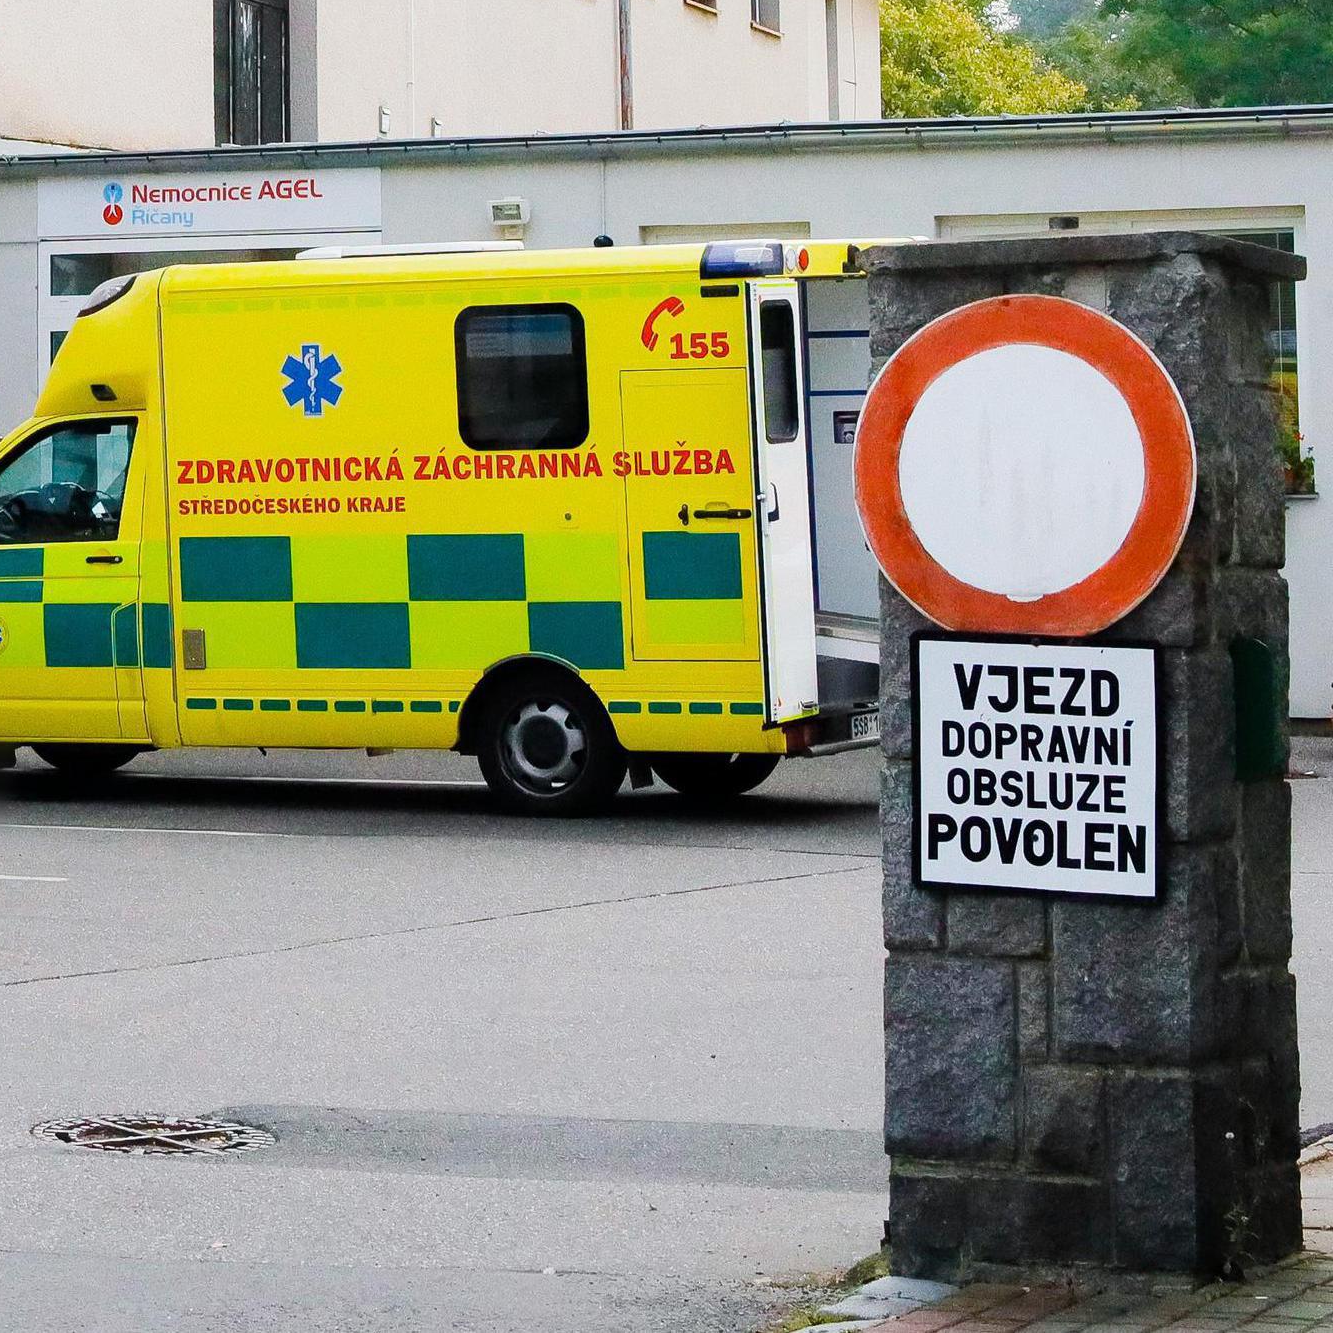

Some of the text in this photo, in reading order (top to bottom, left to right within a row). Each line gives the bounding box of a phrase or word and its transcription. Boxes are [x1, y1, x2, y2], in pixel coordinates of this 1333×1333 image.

[131, 179, 323, 204] Nemocnice AGEL
[131, 205, 194, 227] Říčany
[669, 332, 730, 360] 155
[177, 440, 736, 485] ZDRAVOTNICKÁ ZÁCHRANNÁ SLUŽBA
[178, 493, 406, 515] STŘEDOČESKÉHO KRAJE
[953, 662, 1120, 717] VJEZD
[941, 720, 1135, 766] DOPRAVNÍ
[947, 767, 1127, 814] OBSLUZE
[927, 813, 1147, 874] POVOLEN
